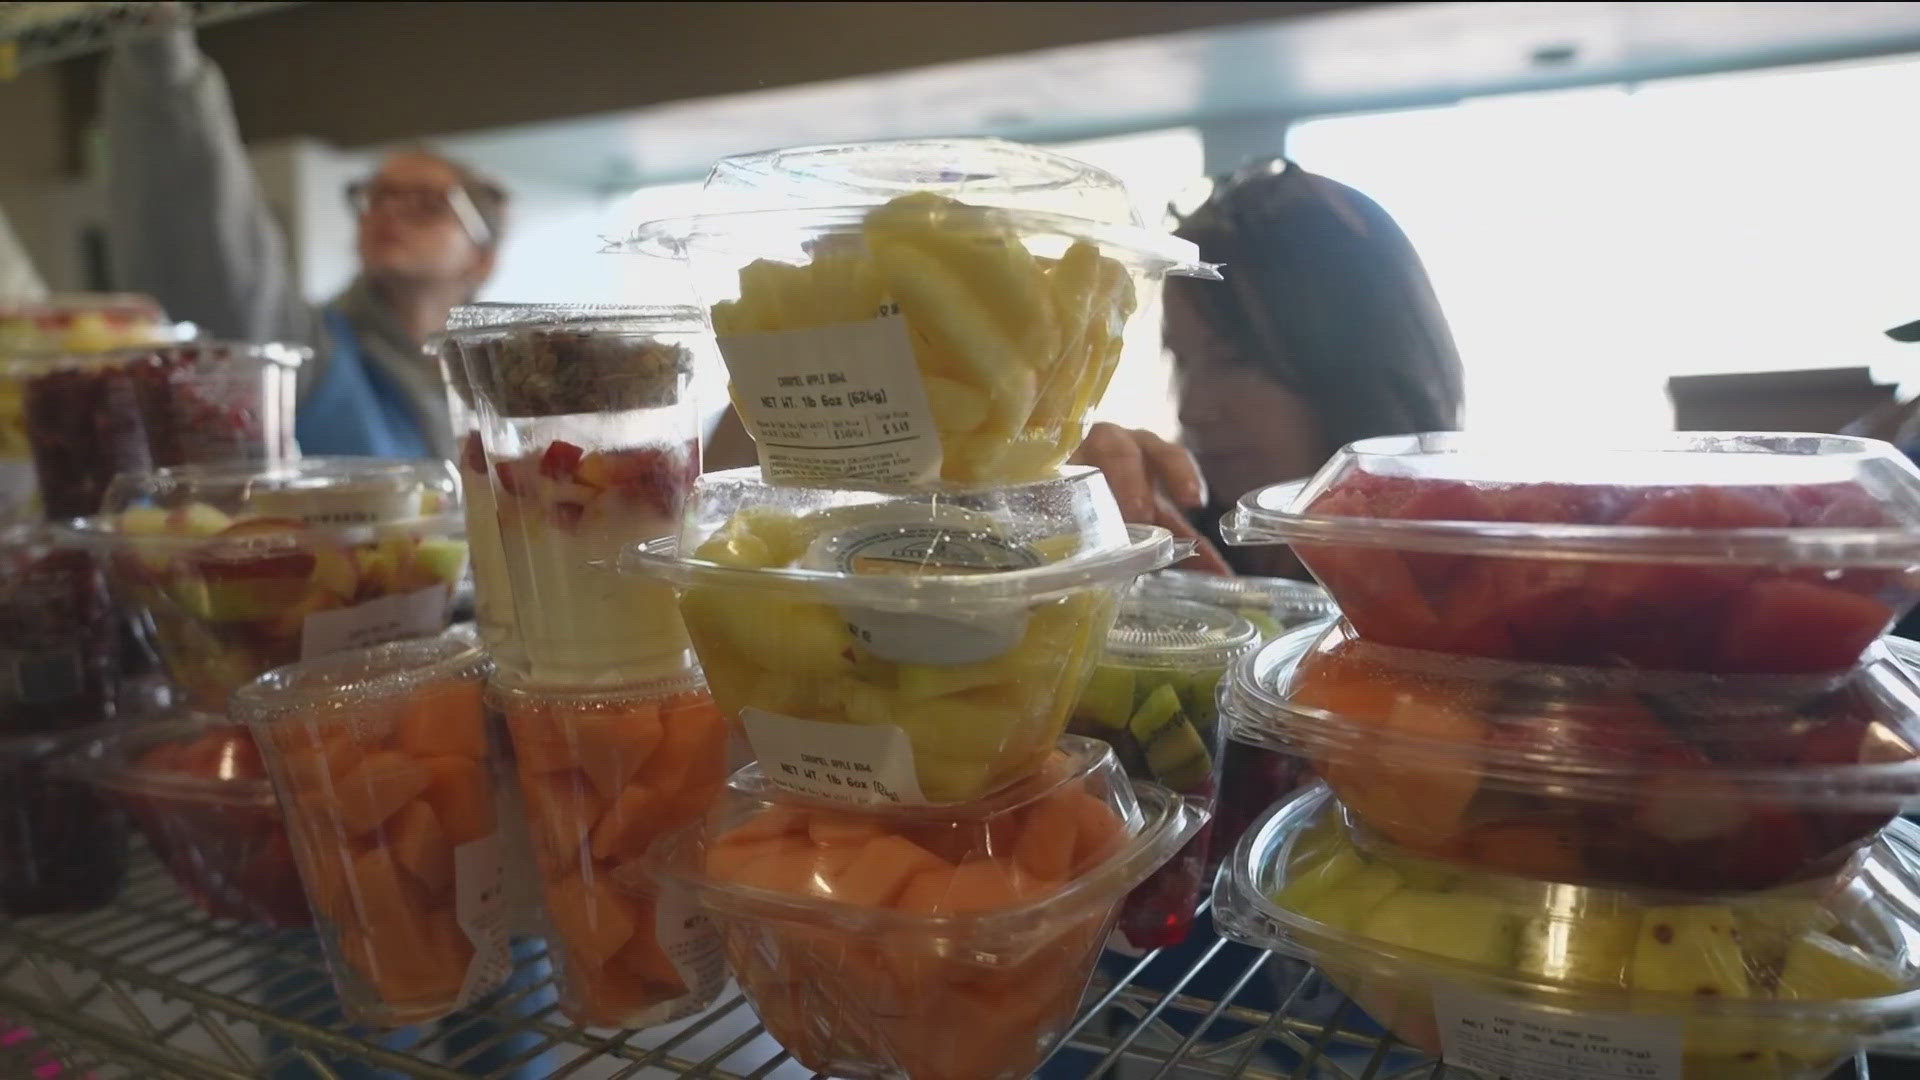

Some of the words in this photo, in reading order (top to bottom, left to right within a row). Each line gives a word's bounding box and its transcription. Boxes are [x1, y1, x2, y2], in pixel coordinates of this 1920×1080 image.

[760, 395, 777, 408] NET
[802, 394, 817, 408] 1lb
[821, 394, 843, 407] 6oz
[847, 388, 887, 407] (624g)
[780, 762, 798, 775] NET
[827, 773, 842, 785] 1lb
[846, 777, 868, 789] 6oz
